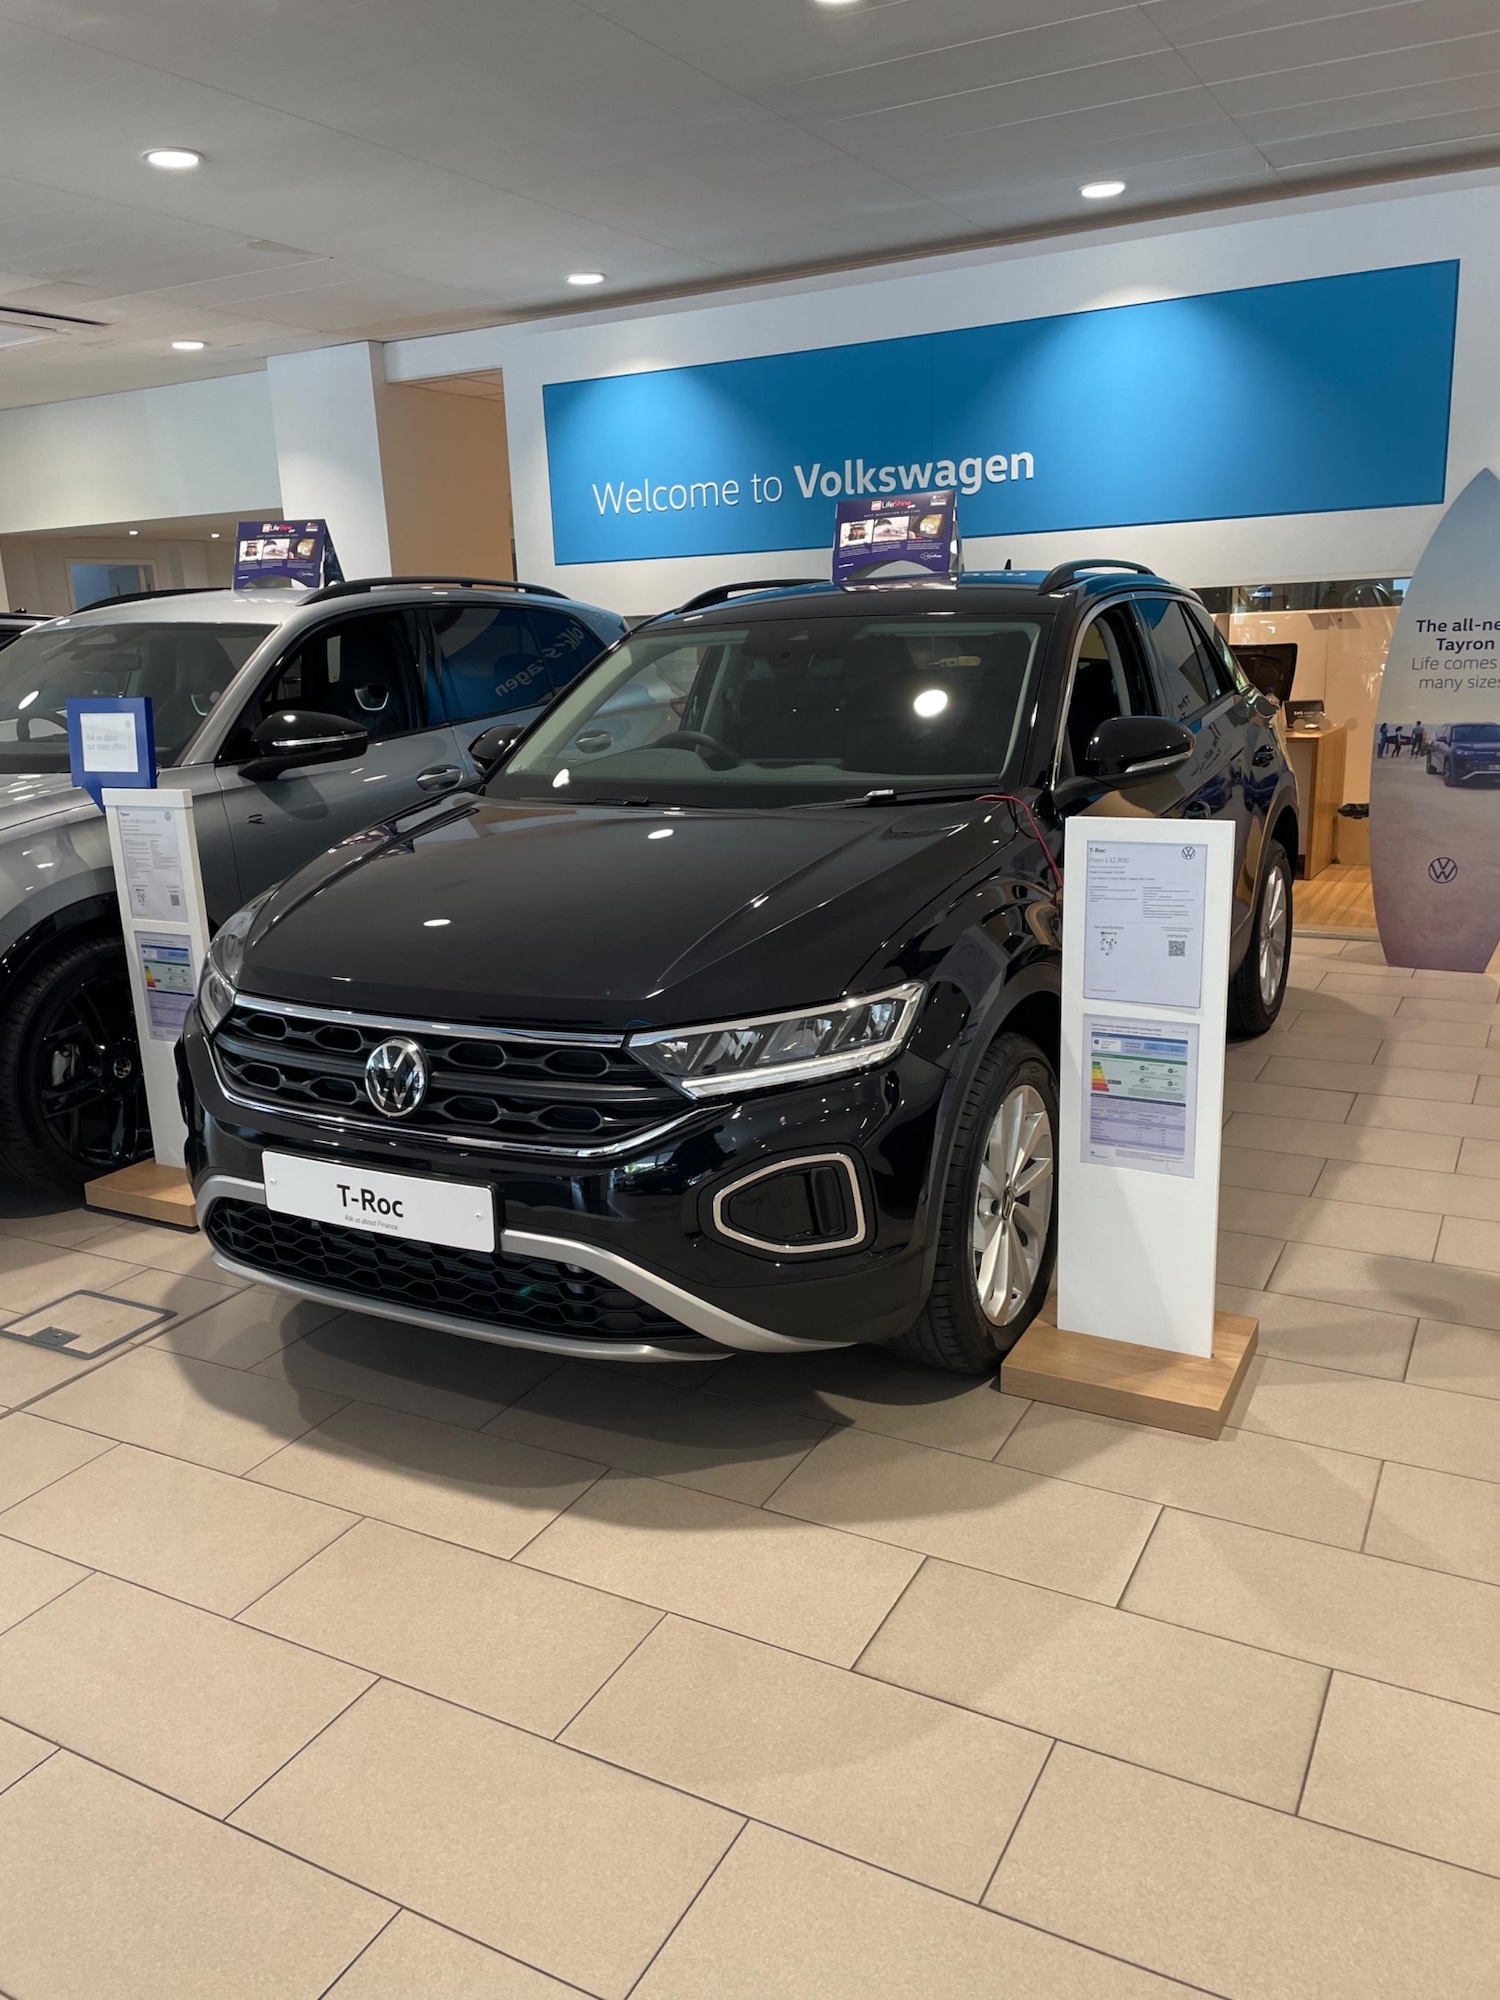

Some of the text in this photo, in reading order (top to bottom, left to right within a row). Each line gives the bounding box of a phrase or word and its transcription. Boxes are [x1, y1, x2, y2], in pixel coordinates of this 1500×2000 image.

[591, 450, 1035, 515] Welcome to Volkswagen
[1416, 618, 1500, 632] The all-ne
[1436, 637, 1495, 654] Tayron
[1412, 656, 1498, 671] Life comes
[1419, 677, 1464, 692] many
[337, 1184, 404, 1218] T-Roc
